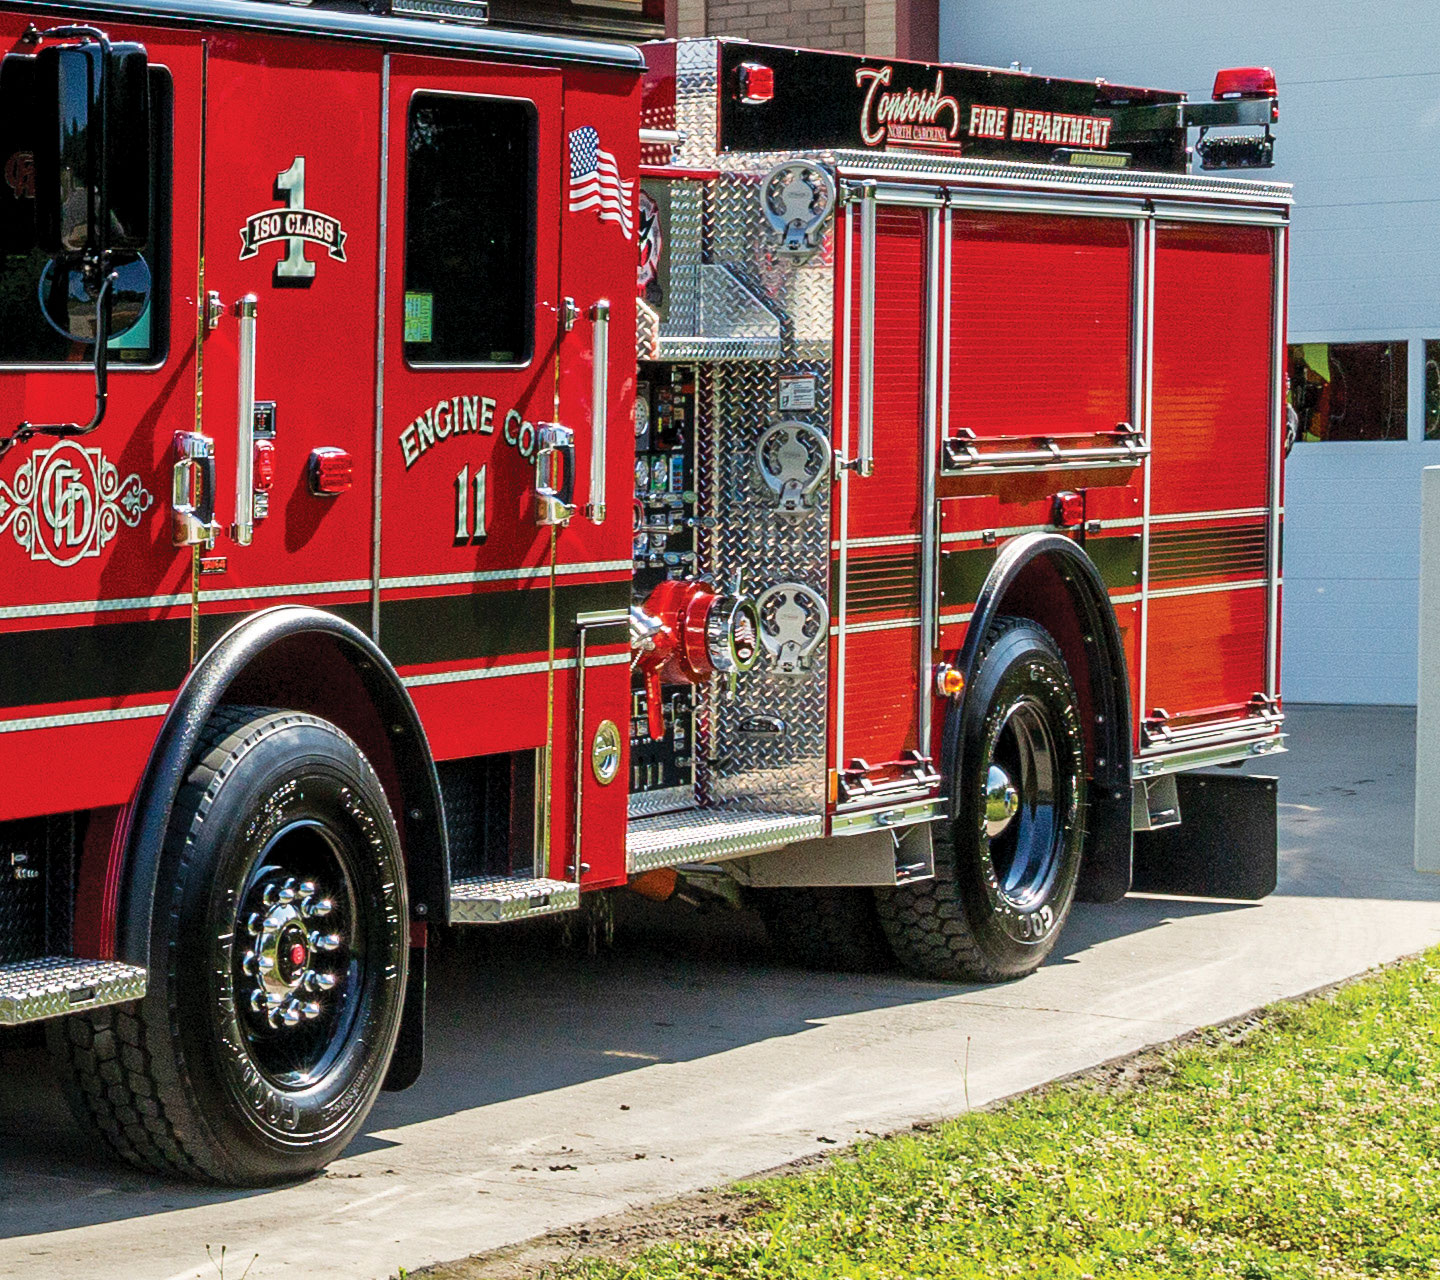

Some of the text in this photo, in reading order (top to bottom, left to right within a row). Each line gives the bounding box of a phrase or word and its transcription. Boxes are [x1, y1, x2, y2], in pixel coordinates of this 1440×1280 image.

[856, 66, 959, 145] Concord
[888, 124, 948, 141] NORTH CAROLINA
[969, 106, 1112, 148] FIRE DEPARTMENT
[253, 213, 334, 242] ISO CLASS
[277, 156, 316, 277] 1
[399, 396, 535, 468] ENGINE CO.
[456, 463, 487, 538] 11
